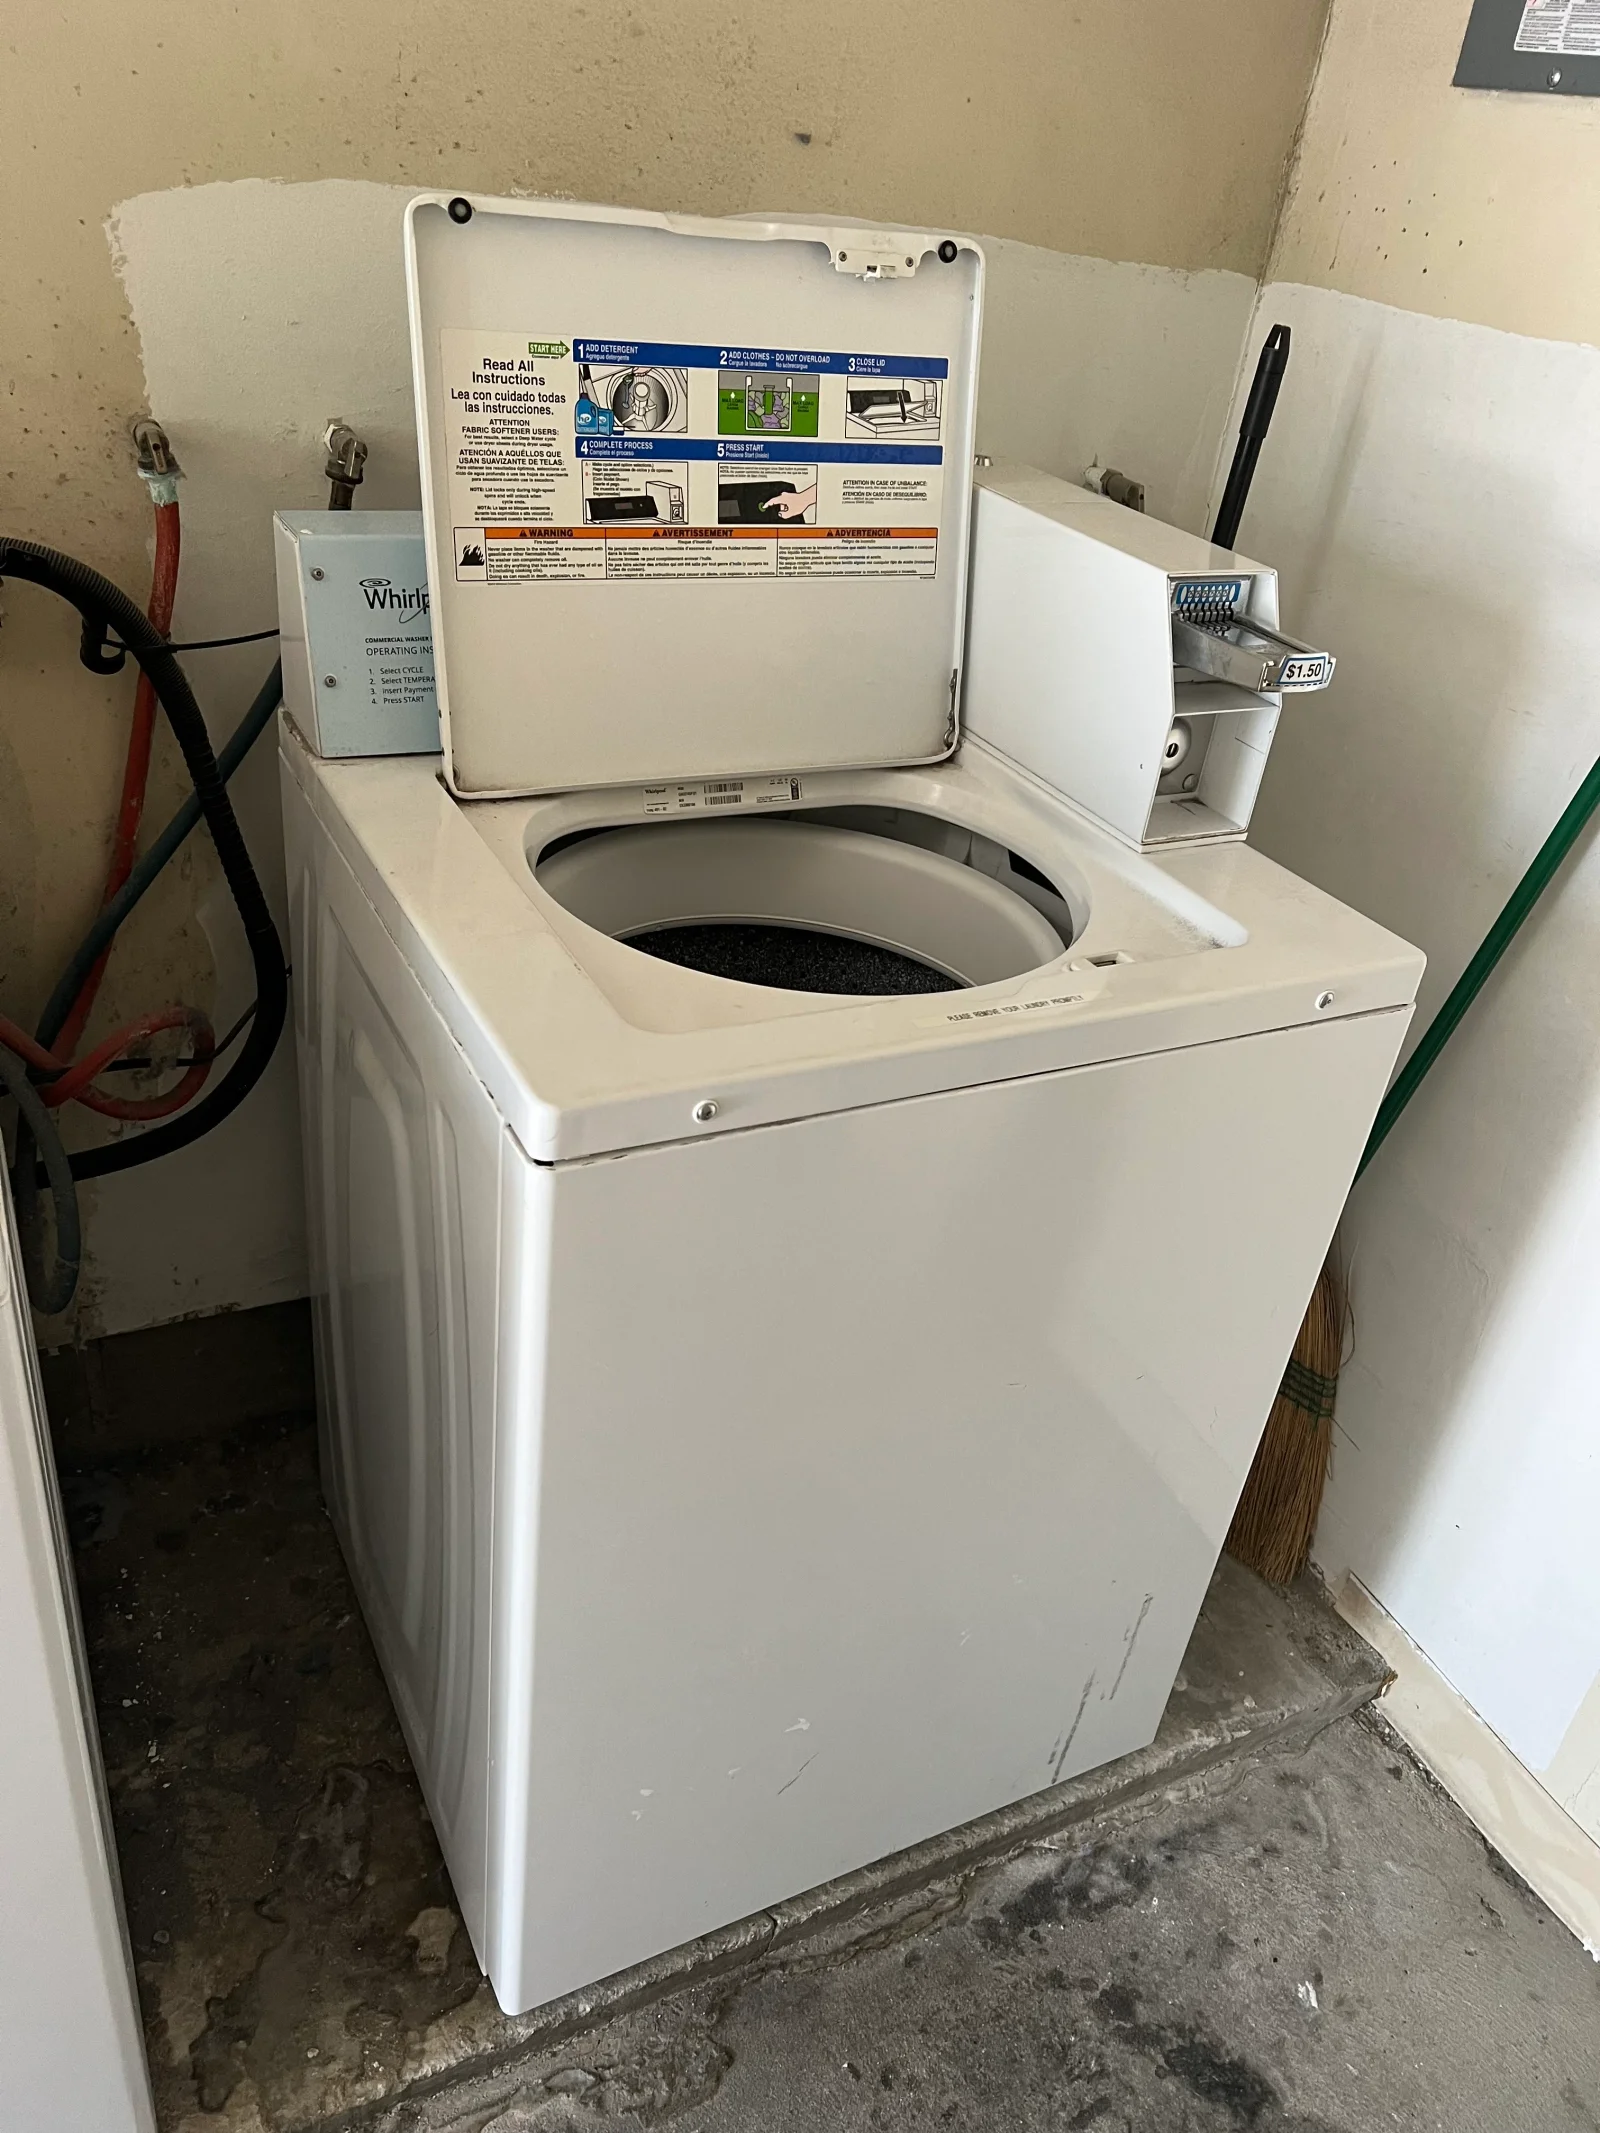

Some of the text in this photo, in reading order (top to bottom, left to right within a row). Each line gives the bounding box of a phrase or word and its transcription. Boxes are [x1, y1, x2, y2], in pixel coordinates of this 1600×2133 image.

[551, 346, 567, 354] HERE
[578, 344, 583, 358] 1
[601, 345, 638, 354] DETERGENT
[720, 351, 727, 364] 2
[483, 359, 533, 371] Read All
[849, 358, 855, 371] 3
[473, 372, 545, 385] Instructions
[452, 388, 566, 403] Lea con cuidado todas
[465, 402, 553, 414] las instrucciones.
[581, 441, 588, 454] 4
[718, 444, 724, 457] 5
[366, 647, 417, 656] OPERATING
[1286, 663, 1321, 679] $1.50
[973, 1008, 1000, 1018] REMOVE
[1021, 1001, 1049, 1010] LAUNDRY
[1051, 995, 1084, 1004] PROMPTLY
